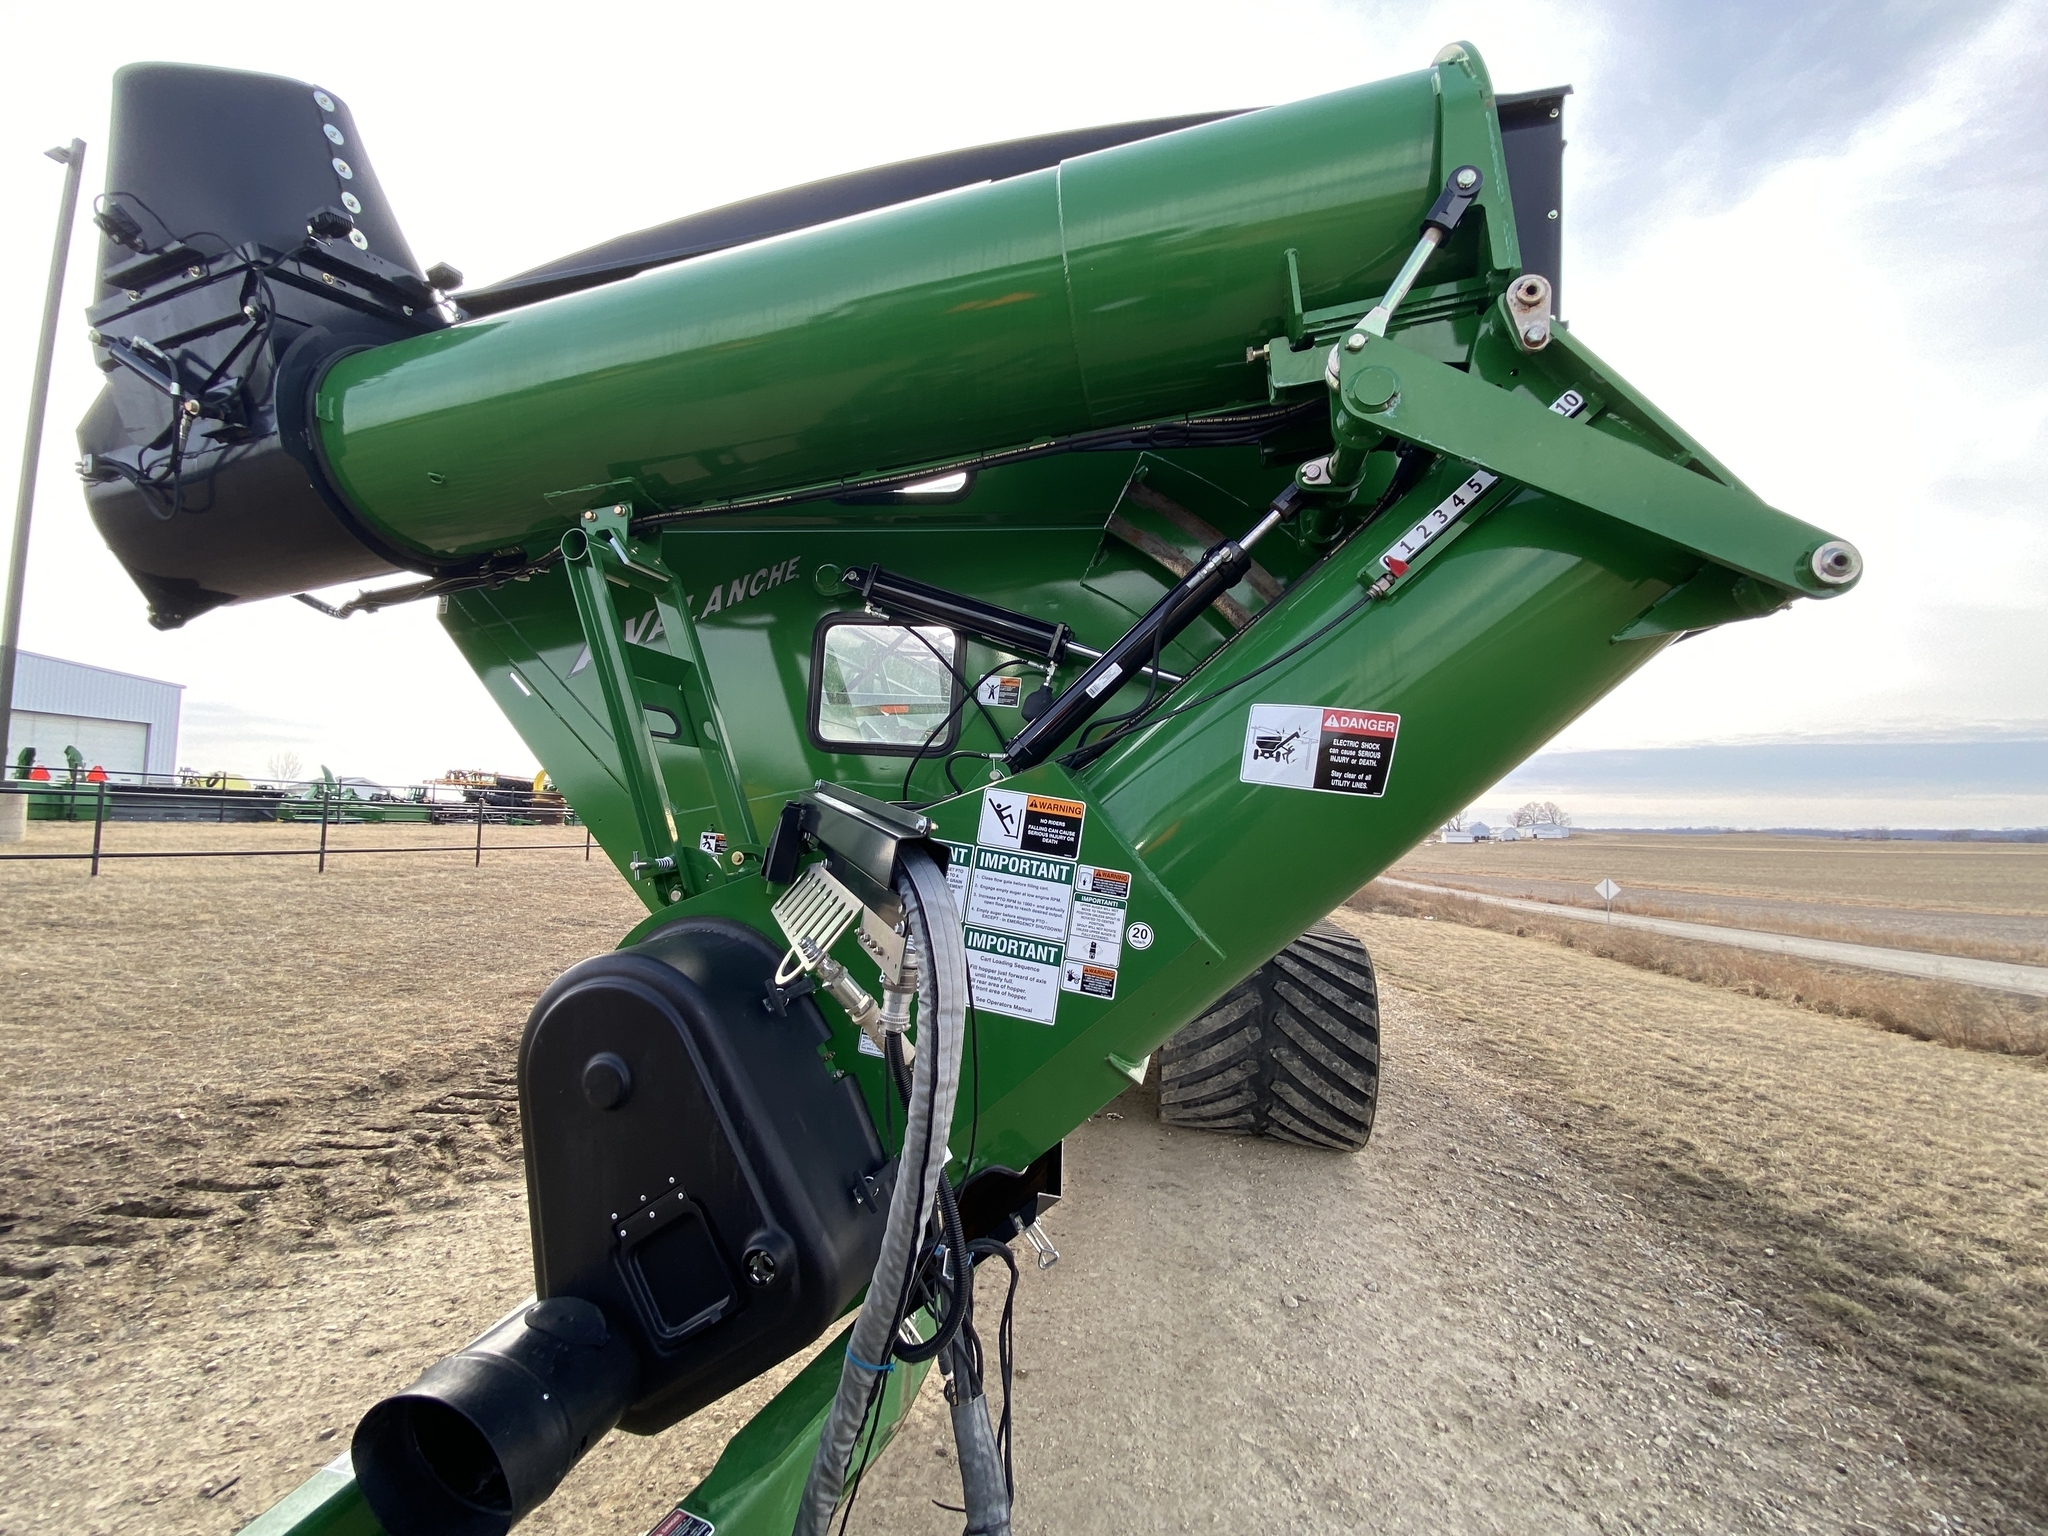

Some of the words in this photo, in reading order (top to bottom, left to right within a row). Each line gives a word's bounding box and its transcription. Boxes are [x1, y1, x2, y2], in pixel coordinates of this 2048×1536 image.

[1555, 394, 1579, 415] 10
[1400, 541, 1415, 554] 1
[1416, 524, 1432, 539] 2
[1433, 509, 1448, 524] 3
[1452, 494, 1465, 507] 4
[1467, 478, 1482, 493] 5
[1340, 716, 1395, 732] DANGER
[1333, 739, 1359, 748] ELECTRIC
[1361, 742, 1380, 750] SHOCK
[1330, 755, 1349, 763] INJURY
[1358, 750, 1381, 759] SERIOUS
[1331, 770, 1342, 778] Stay
[1331, 779, 1350, 787] UTILITY
[1039, 802, 1081, 814] WARNING
[980, 852, 1070, 881] IMPORTANT
[1102, 872, 1127, 881] WARNING
[1082, 896, 1118, 907] IMPORTANT!
[1007, 919, 1034, 927] EMERGENCY
[1035, 924, 1062, 932] SHUTDOWN!
[1132, 928, 1148, 939] 20
[968, 931, 1058, 963] IMPORTANT
[993, 958, 1013, 967] Loading
[1014, 963, 1040, 972] Sequence
[979, 965, 996, 974] hopper
[1008, 972, 1028, 980] forward
[1007, 985, 1026, 993] hopper.
[1008, 991, 1027, 1000] hopper.
[987, 998, 1012, 1008] Operators
[1013, 1004, 1032, 1013] Manual
[662, 1514, 682, 1532] DANGER
